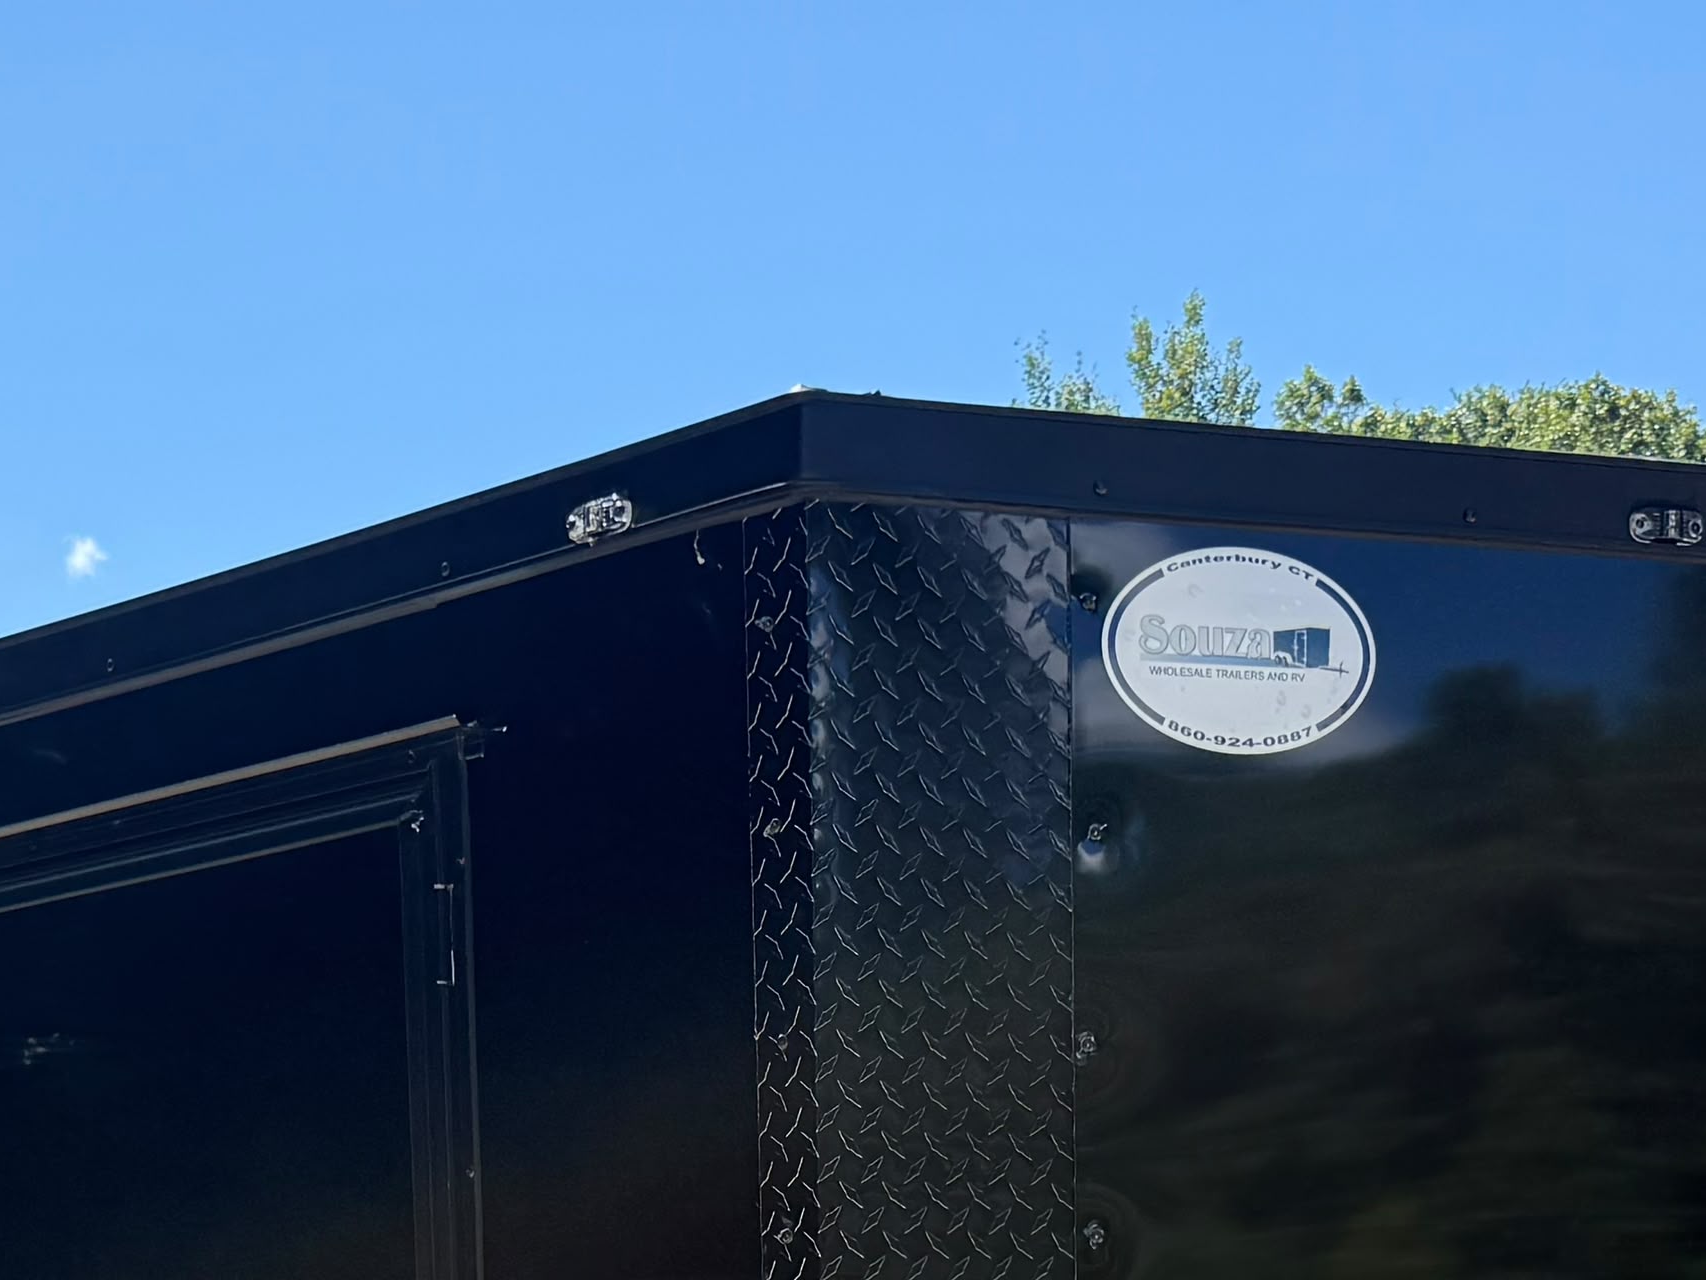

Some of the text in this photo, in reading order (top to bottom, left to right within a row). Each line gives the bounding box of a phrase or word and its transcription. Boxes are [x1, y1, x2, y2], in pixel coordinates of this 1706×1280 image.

[1166, 553, 1314, 581] Canterbury CT
[1138, 614, 1272, 660] Souza
[1148, 665, 1306, 683] WHOLESALE TRAILERS AND RV
[1167, 718, 1313, 748] 860-924-0887
